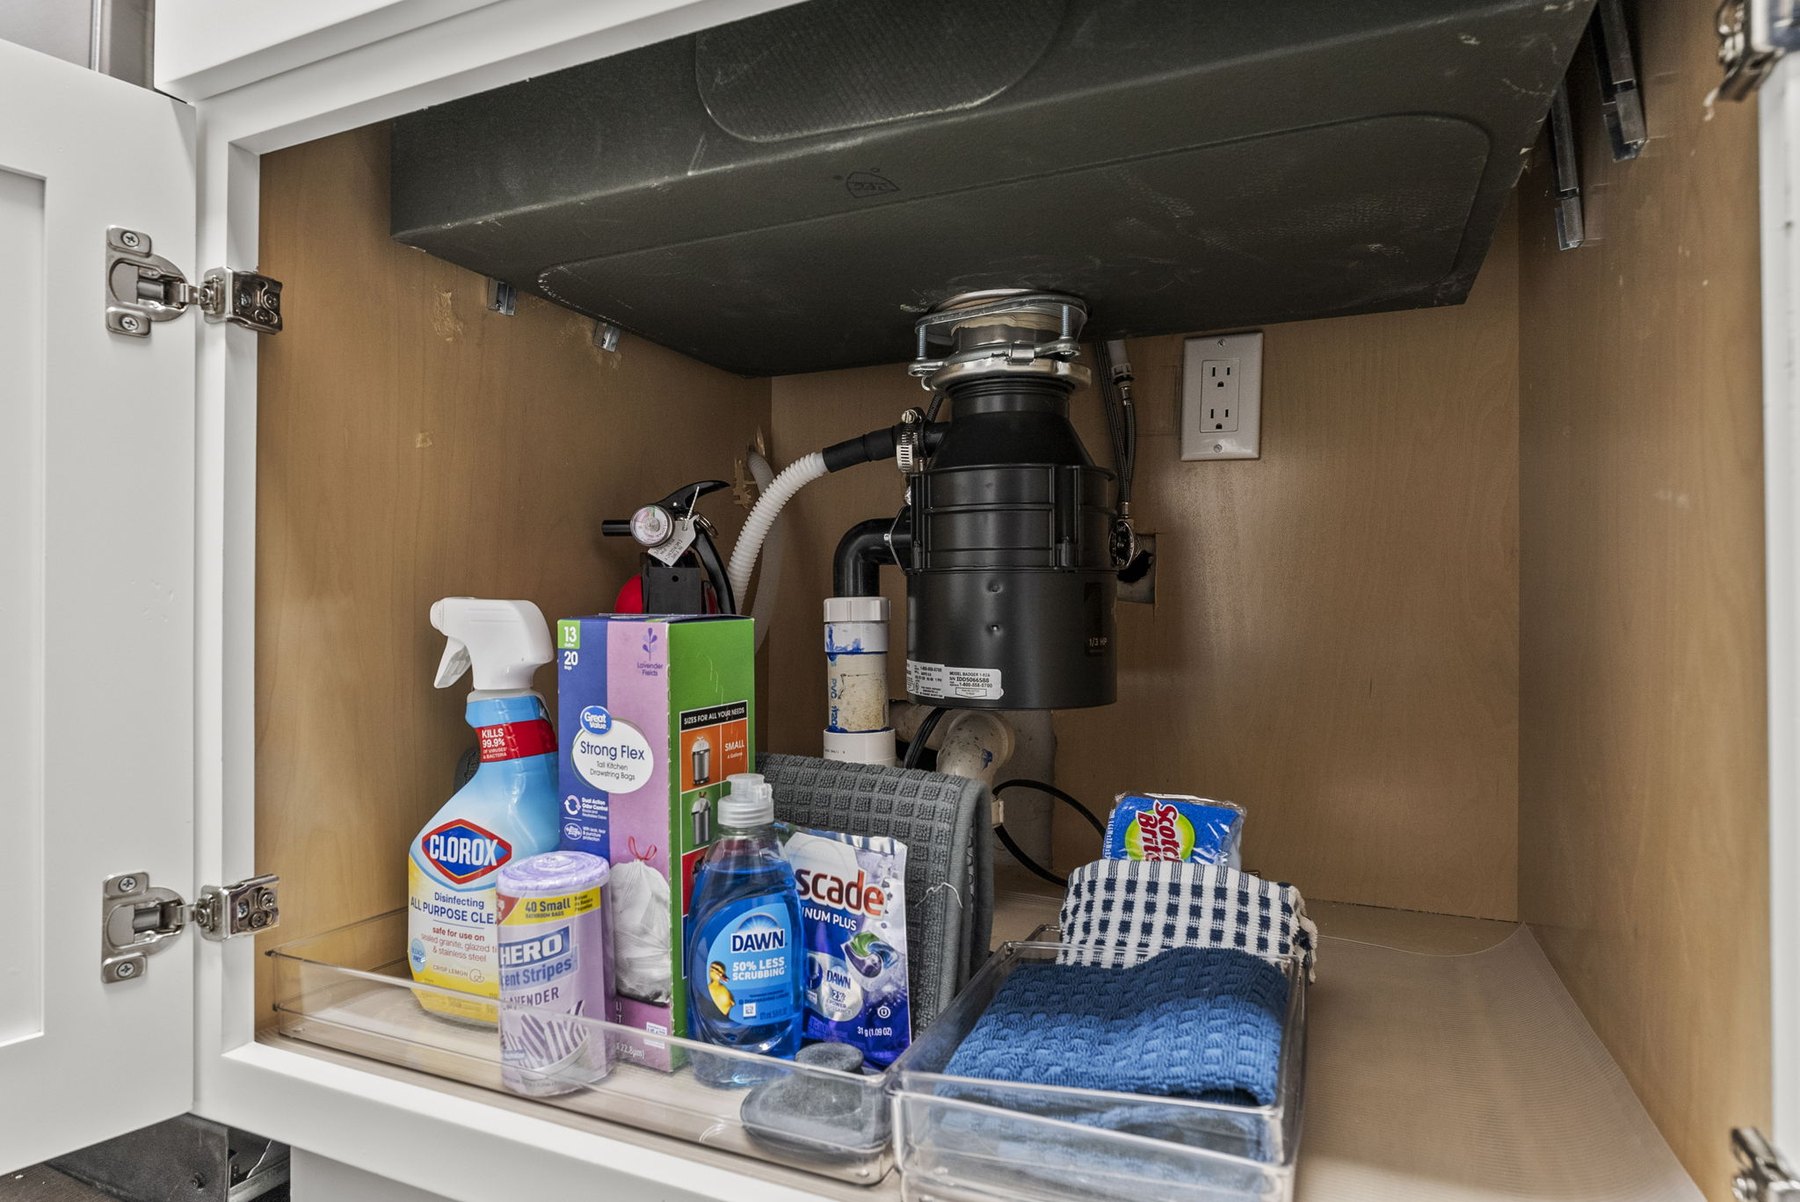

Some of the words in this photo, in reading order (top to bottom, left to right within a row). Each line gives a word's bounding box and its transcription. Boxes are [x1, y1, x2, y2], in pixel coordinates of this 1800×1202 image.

[564, 626, 577, 642] 13
[1089, 637, 1098, 647] 1/3
[564, 651, 578, 666] 20
[584, 711, 607, 723] Great
[684, 715, 697, 725] SIZES
[697, 714, 708, 722] FOR
[708, 712, 718, 720] ALL
[718, 709, 731, 718] YOUR
[731, 707, 745, 715] NEEDS
[481, 728, 504, 739] KILLS
[482, 738, 506, 748] 99.9%
[580, 740, 617, 760] Strong
[620, 745, 645, 760] Flex
[724, 739, 745, 752] SMALL
[606, 762, 628, 771] Kitchen
[590, 768, 619, 779] Drawstring
[620, 772, 636, 781] Bags
[429, 834, 498, 866] CLOROX
[795, 869, 885, 916] scade
[434, 892, 484, 910] Disinfecting
[525, 901, 538, 912] 40
[539, 897, 571, 912] Small
[411, 896, 422, 911] ALL
[423, 902, 468, 922] PURPOSE
[470, 911, 497, 925] CLE
[525, 911, 550, 919] BATHROOM
[801, 907, 831, 923] INUM
[832, 913, 857, 931] PLUS
[432, 927, 446, 936] safe
[447, 928, 457, 937] for
[459, 932, 473, 940] use
[475, 934, 485, 942] on
[732, 930, 784, 951] DAWN
[438, 948, 467, 960] stainless
[468, 951, 486, 961] steel
[464, 942, 490, 952] glazed
[500, 934, 562, 965] HERO
[432, 964, 447, 972] CRISP
[448, 968, 468, 977] LEMON
[522, 958, 572, 986] Stripes
[733, 961, 757, 972] 50%
[759, 957, 785, 970] LESS
[732, 967, 785, 980] SCRUBBING
[827, 970, 851, 990] DAWN
[857, 1026, 864, 1035] 31
